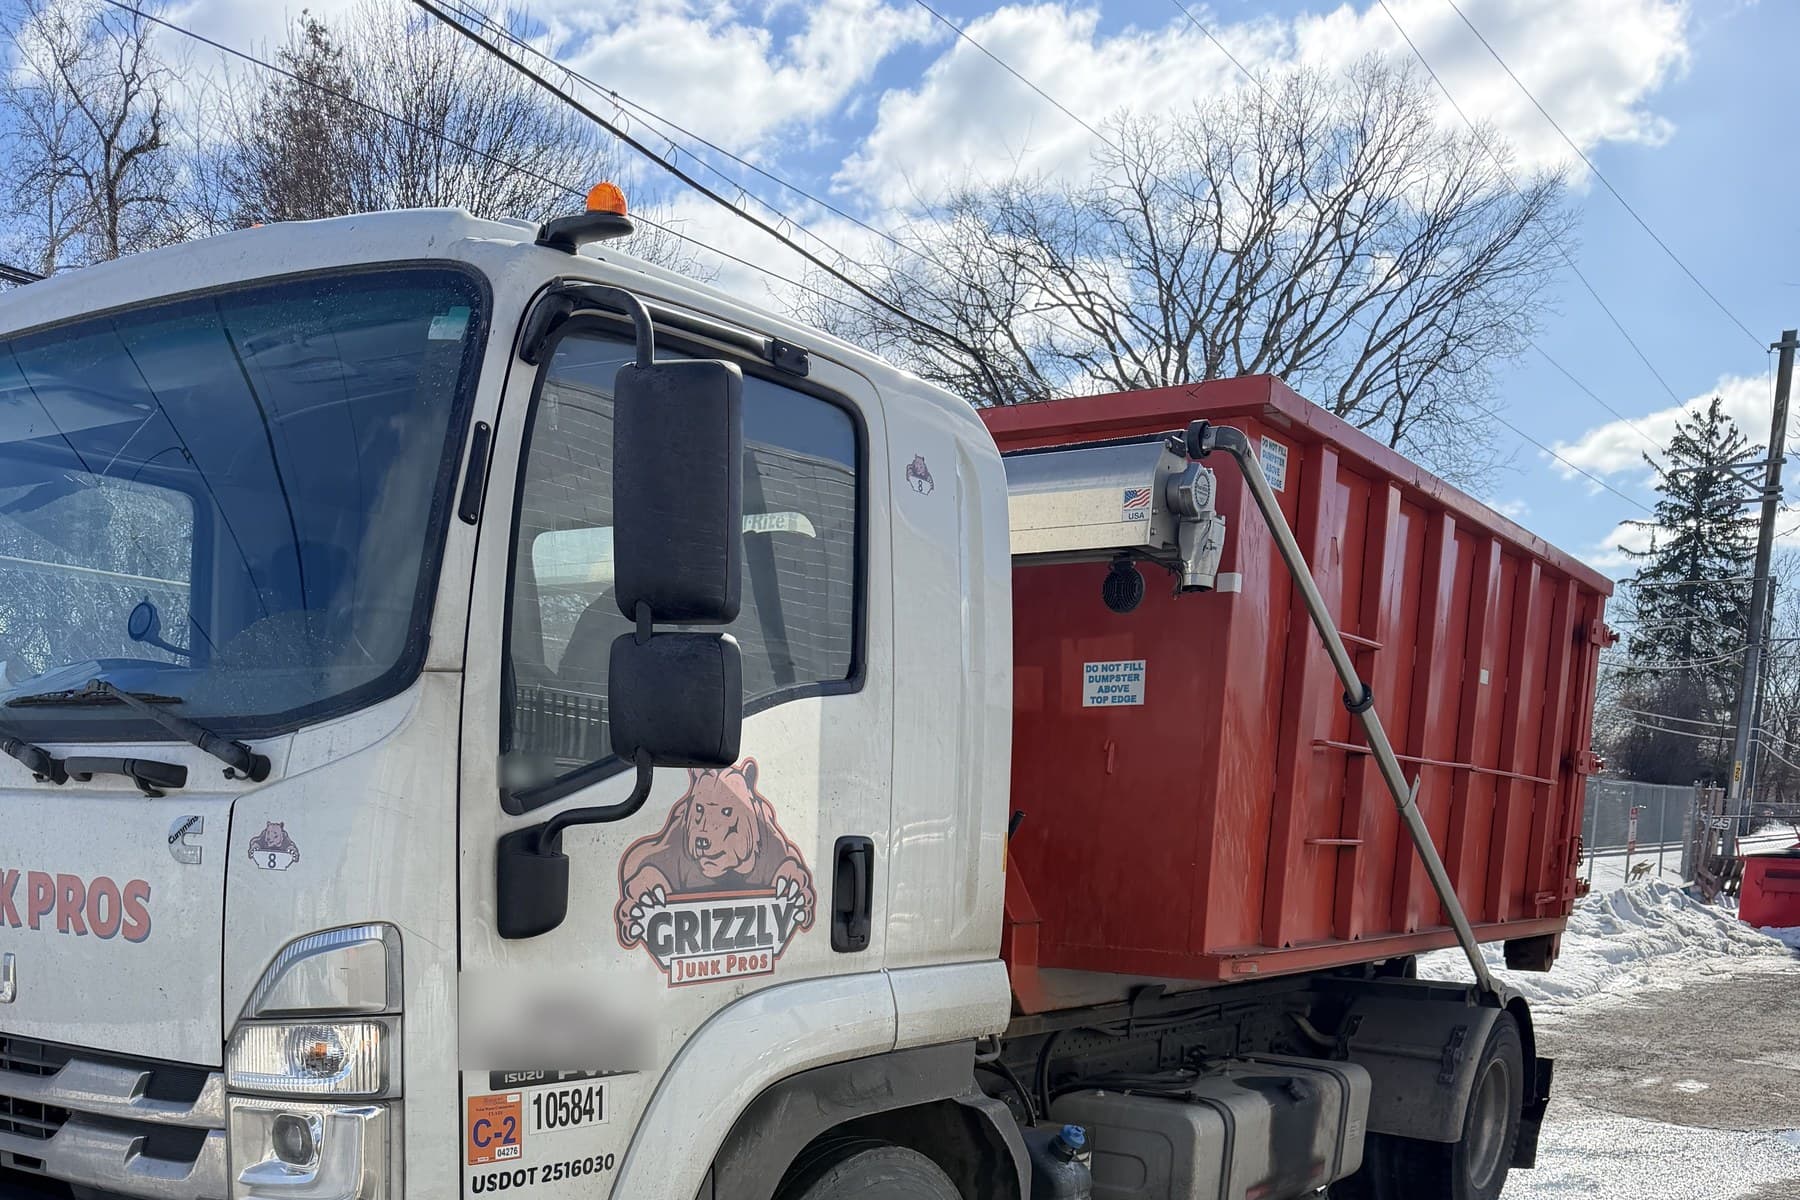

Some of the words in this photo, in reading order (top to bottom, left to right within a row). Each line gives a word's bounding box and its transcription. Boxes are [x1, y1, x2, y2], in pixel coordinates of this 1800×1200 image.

[917, 479, 923, 492] 8
[1128, 512, 1144, 520] USA
[1085, 664, 1098, 673] DO
[1101, 663, 1121, 672] NOT
[1124, 662, 1144, 671] FILL
[1088, 673, 1140, 683] DUMPSTER
[1097, 684, 1130, 694] ABOVE
[1090, 696, 1109, 704] TOP
[1111, 694, 1137, 703] EDGE
[168, 815, 199, 844] Cummins
[267, 853, 277, 869] 8
[646, 902, 796, 957] GRIZZLY
[504, 1070, 545, 1084] ISUZU
[532, 1085, 604, 1130] 105841
[472, 1115, 516, 1148] C-2
[472, 1166, 538, 1194] USDOT
[541, 1153, 615, 1183] 2516030
